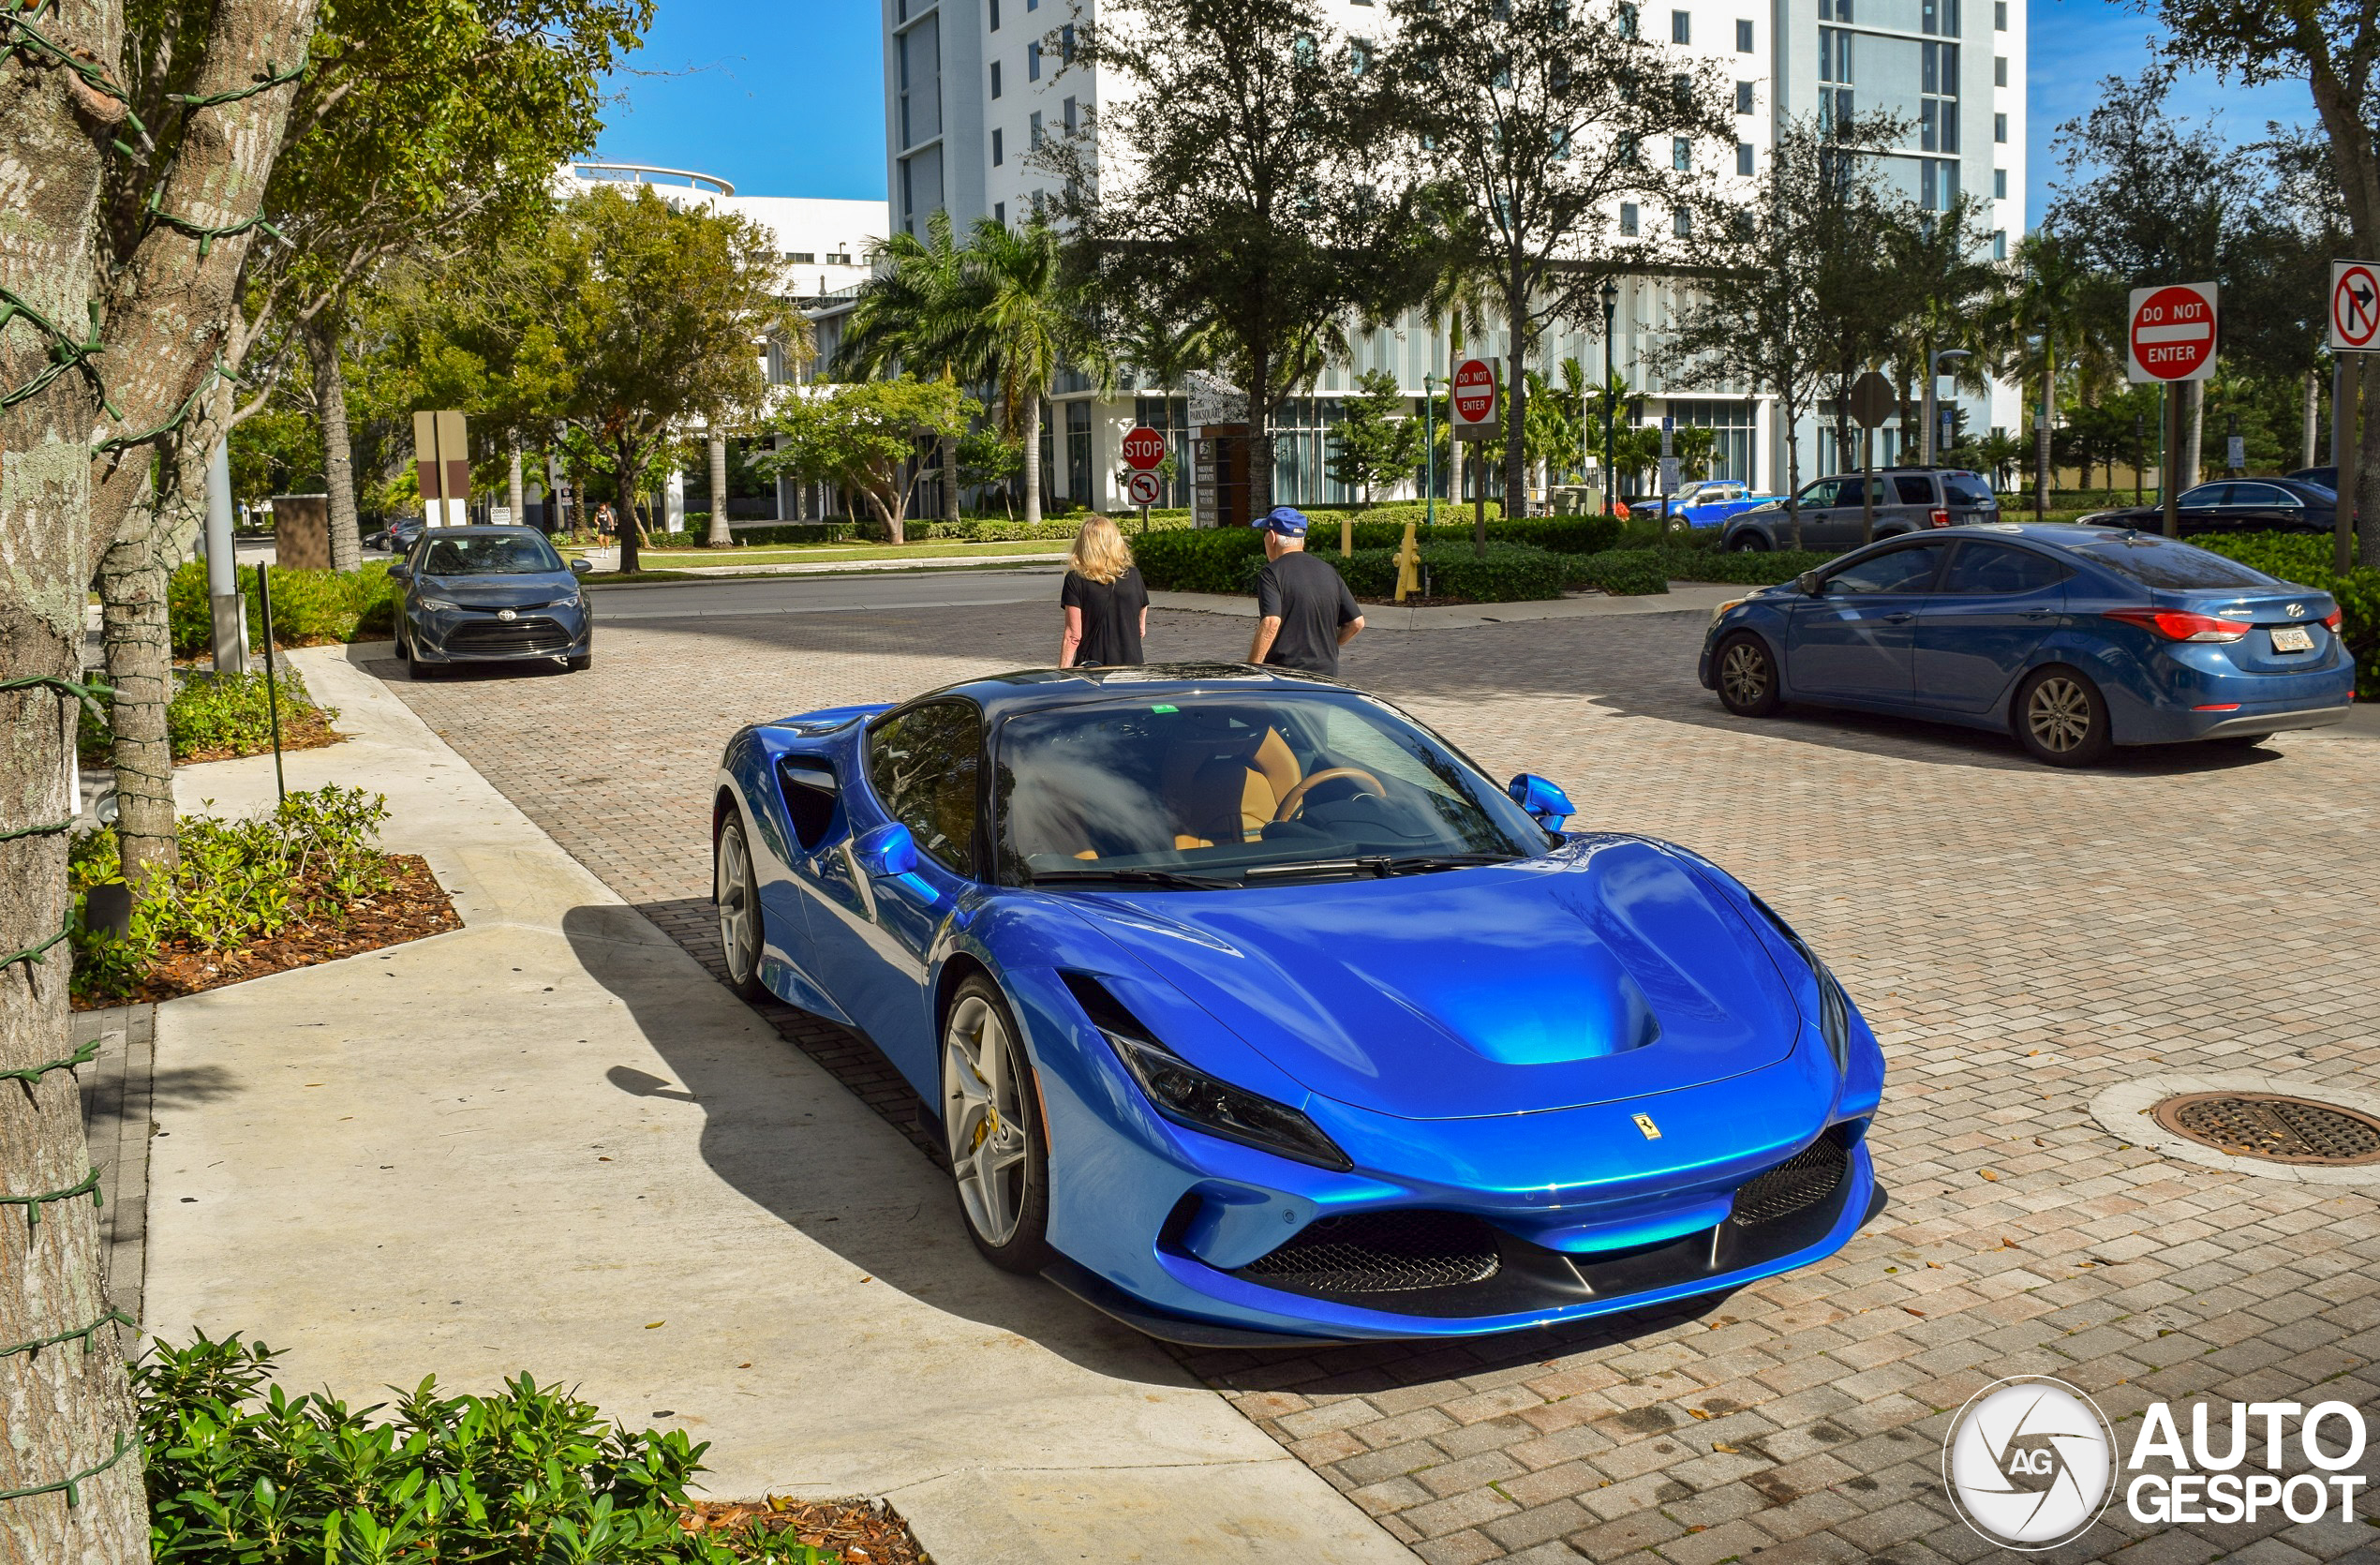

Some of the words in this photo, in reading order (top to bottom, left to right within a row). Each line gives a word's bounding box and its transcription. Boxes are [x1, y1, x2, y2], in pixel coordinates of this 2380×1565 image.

[2143, 307, 2163, 322] DO
[2174, 303, 2203, 320] NOT
[2148, 346, 2195, 363] ENTER
[1459, 373, 1469, 383] DO
[1473, 371, 1487, 382] NOT
[1463, 399, 1485, 411] ENTER
[1124, 440, 1164, 458] STOP
